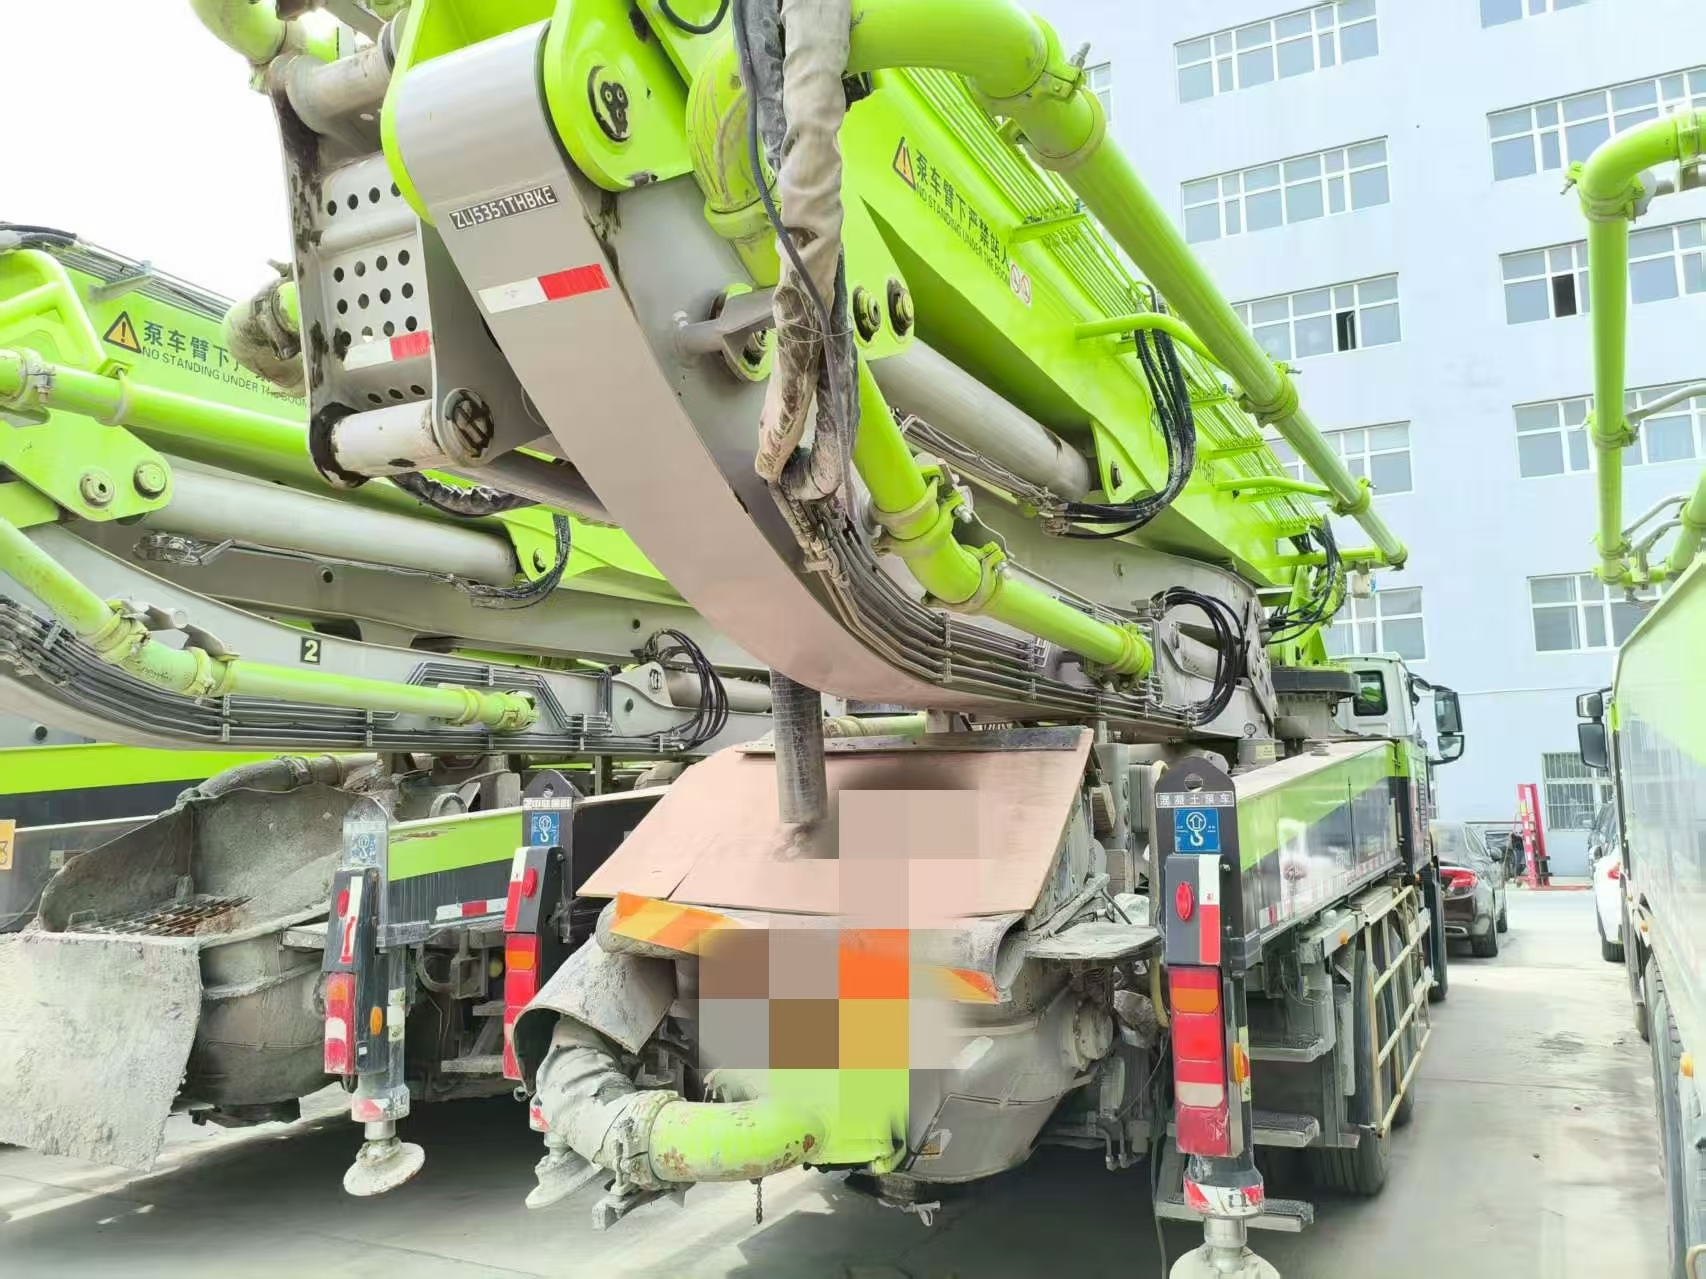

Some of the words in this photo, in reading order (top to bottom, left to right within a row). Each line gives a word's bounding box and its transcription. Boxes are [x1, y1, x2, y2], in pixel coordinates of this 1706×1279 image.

[451, 186, 556, 228] ZLJ5351THBKE
[916, 148, 1010, 272] 泵车臂下严禁站人
[142, 345, 160, 360] NO
[162, 352, 220, 380] STANDING
[223, 373, 258, 393] UNDER
[303, 639, 319, 662] 2
